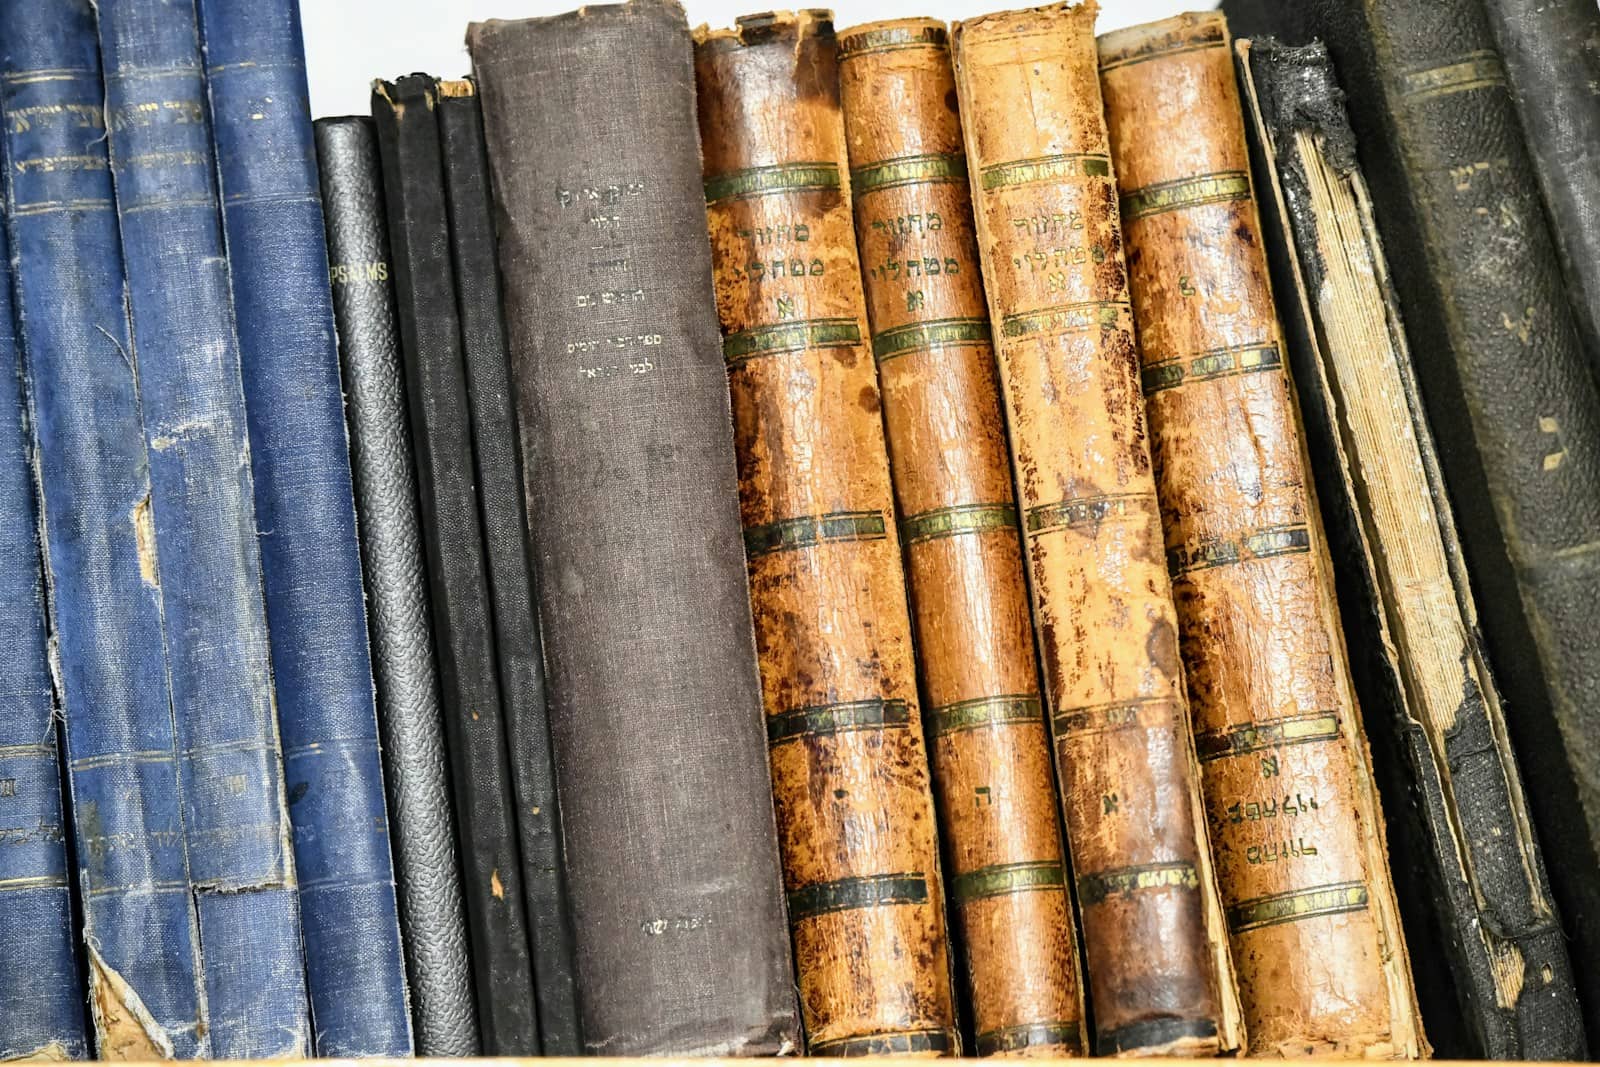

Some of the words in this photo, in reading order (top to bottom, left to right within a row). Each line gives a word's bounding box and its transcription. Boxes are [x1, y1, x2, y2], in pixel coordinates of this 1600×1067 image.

[871, 213, 942, 236] מחזור
[1013, 210, 1085, 237] מחזור
[736, 224, 810, 247] מחזור
[330, 262, 388, 285] PSALMS
[777, 297, 795, 319] א
[906, 290, 925, 313] א
[1261, 755, 1280, 779] א
[975, 786, 992, 808] ה
[1246, 838, 1318, 864] מחזור
